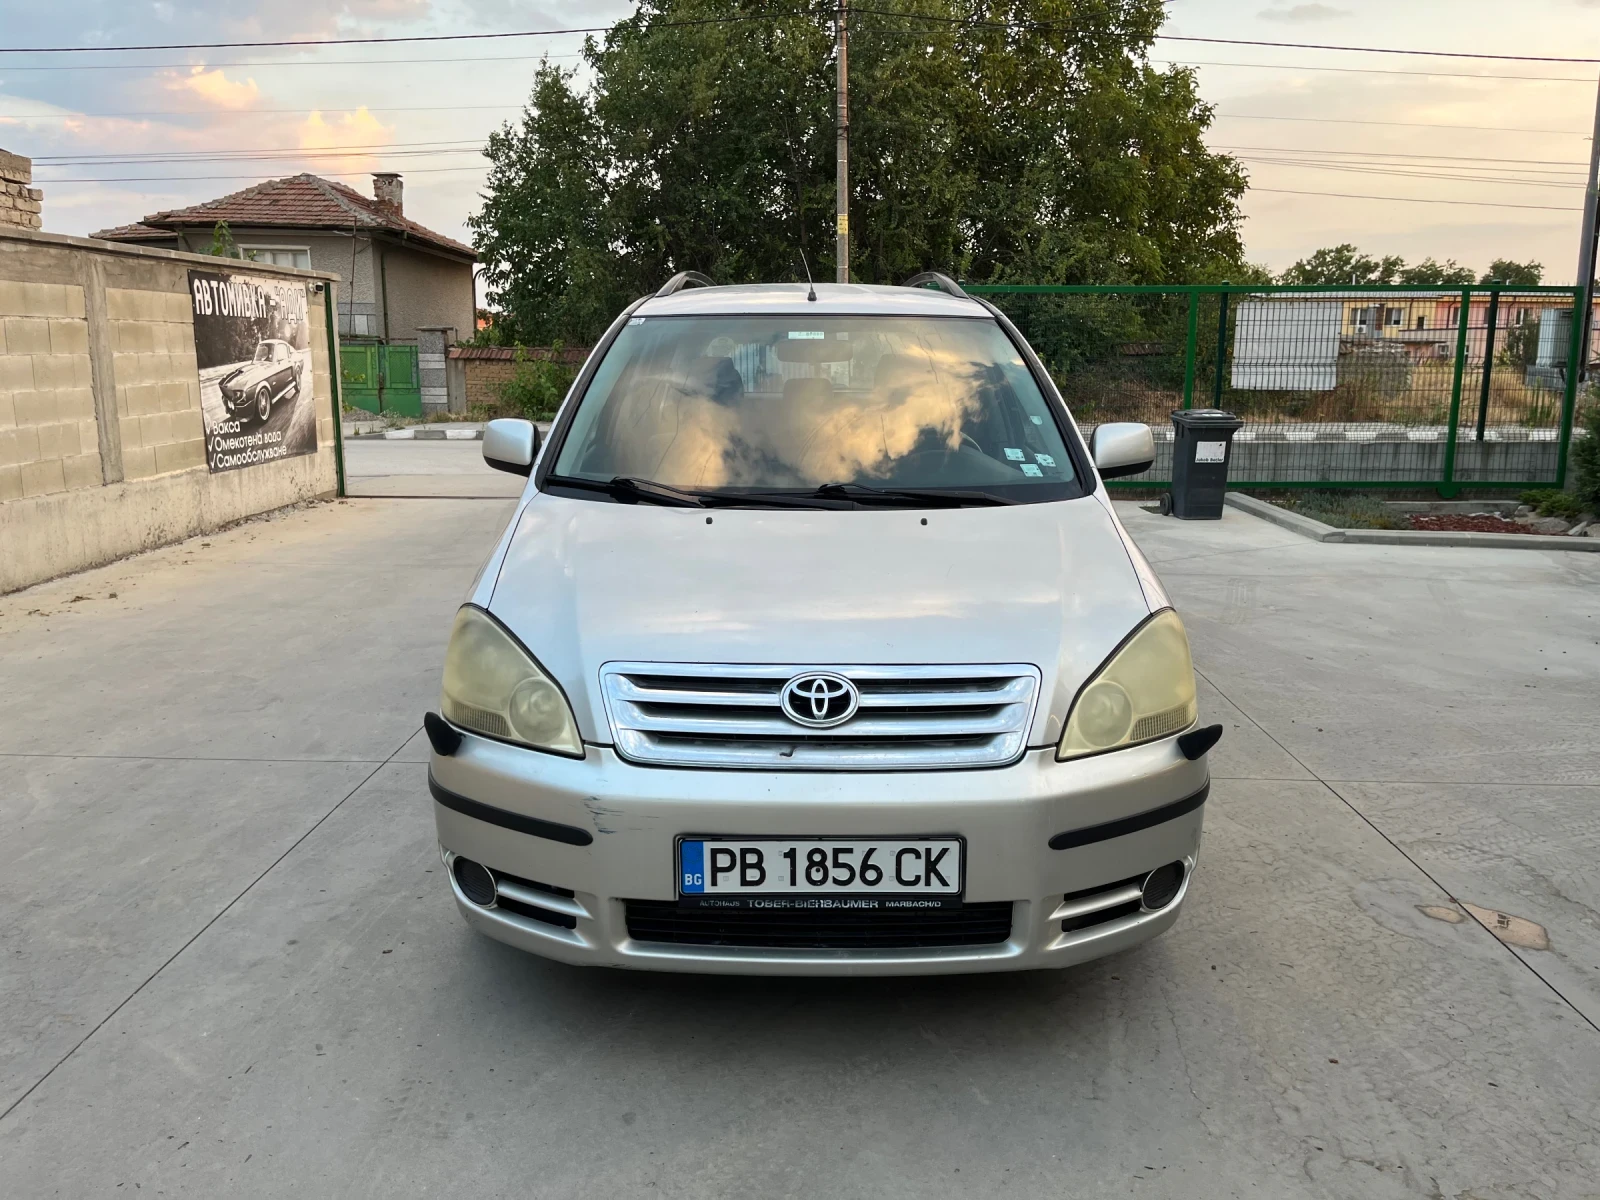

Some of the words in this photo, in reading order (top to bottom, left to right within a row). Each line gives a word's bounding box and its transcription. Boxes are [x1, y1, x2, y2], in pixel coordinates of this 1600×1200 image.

[193, 278, 267, 319] АВТОМИВКА
[213, 420, 241, 435] Вакса
[214, 432, 263, 452] Омекотена
[264, 430, 282, 444] вода
[216, 445, 287, 468] Самообслужване
[710, 847, 766, 887] PB
[783, 847, 884, 887] 1856
[894, 847, 951, 887] CK
[684, 873, 703, 886] BG
